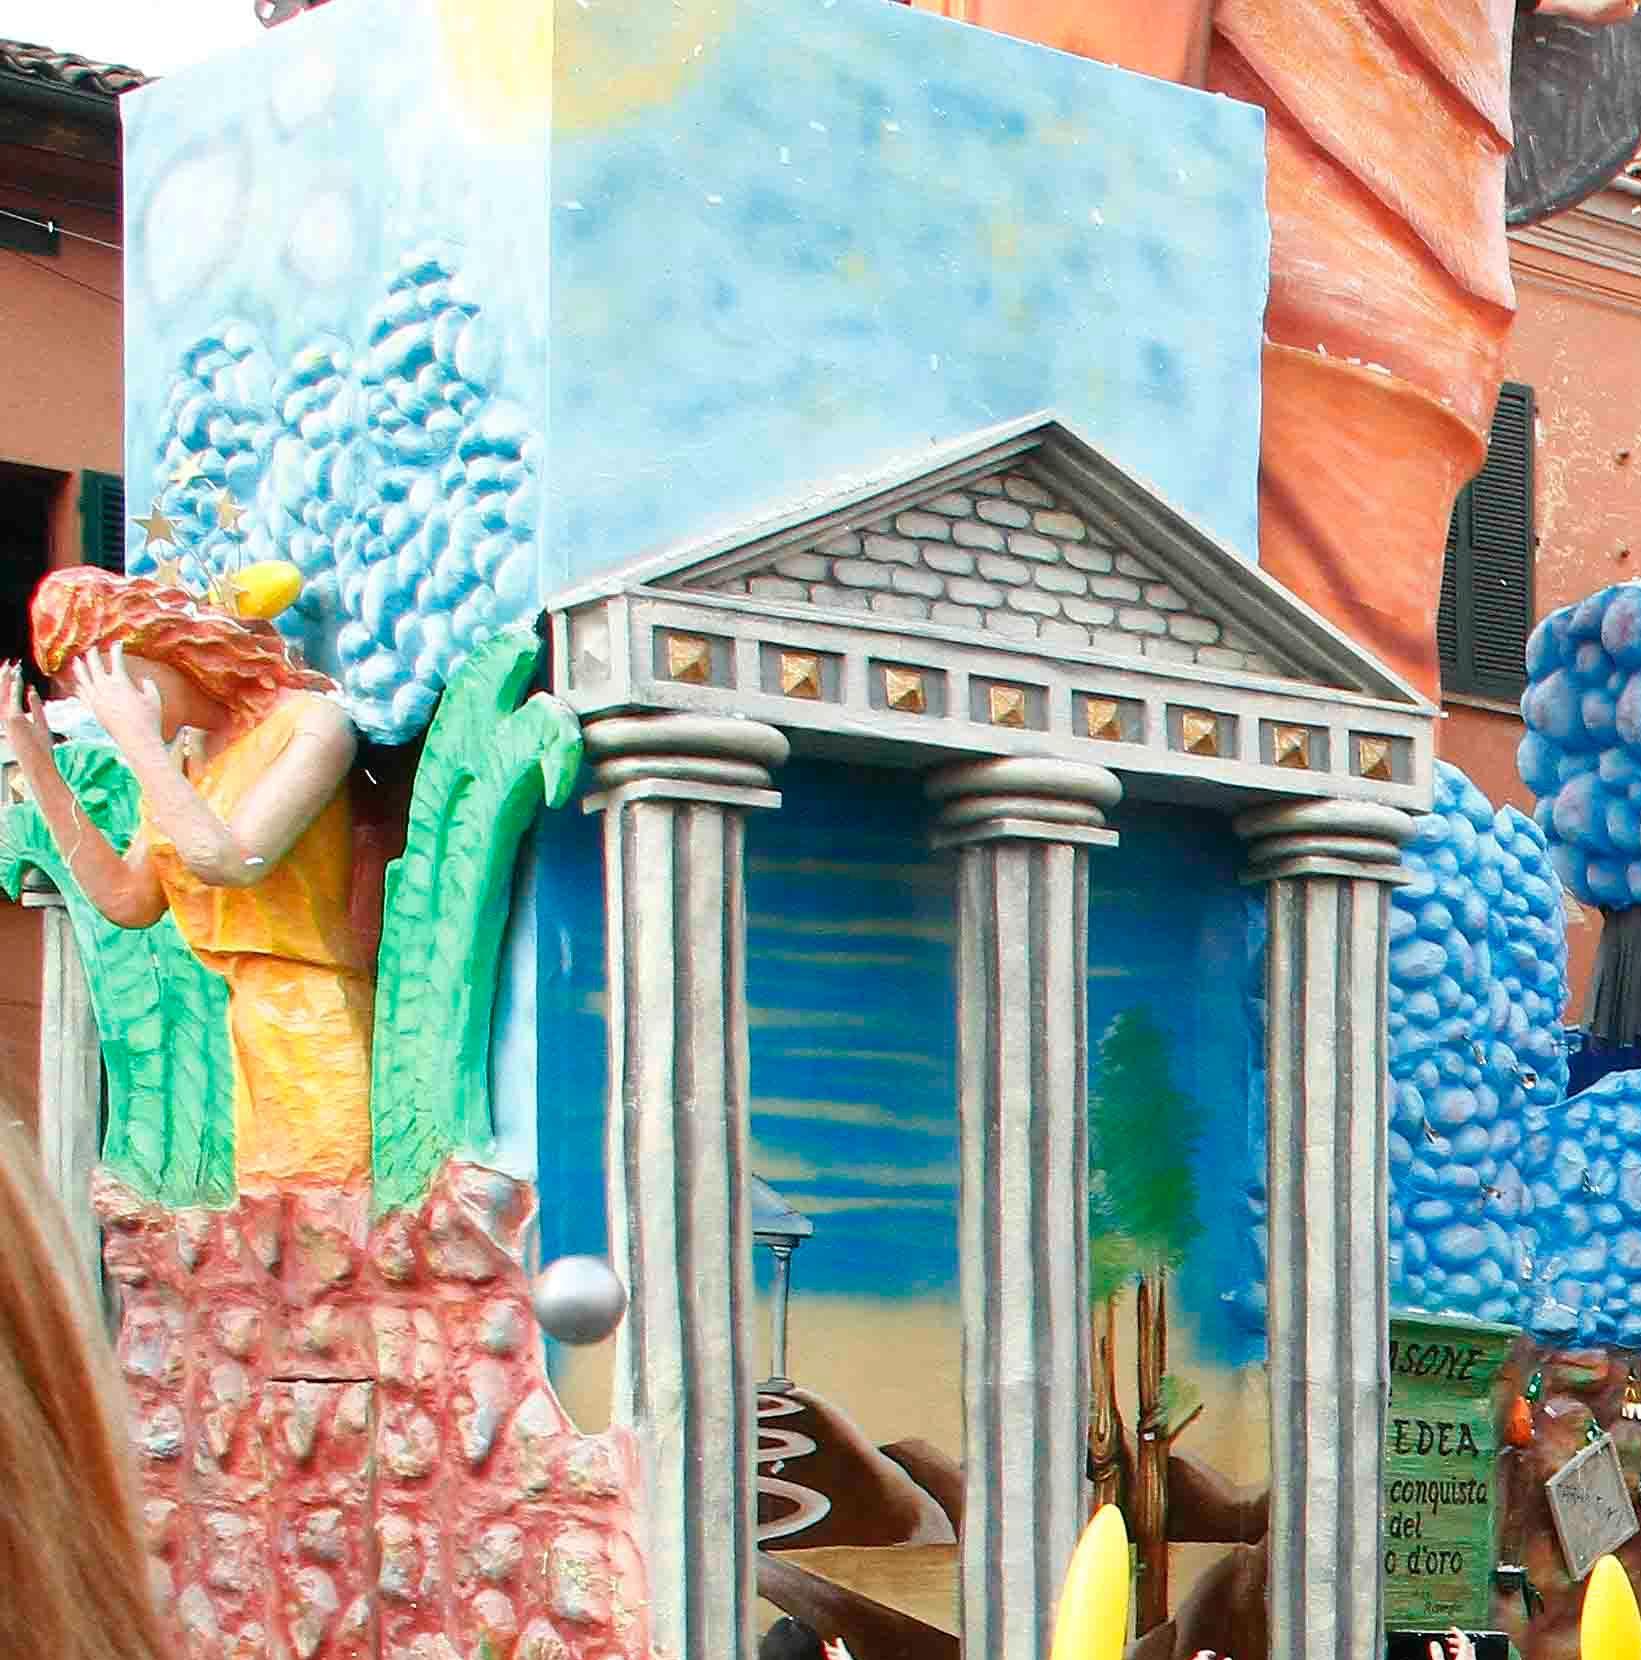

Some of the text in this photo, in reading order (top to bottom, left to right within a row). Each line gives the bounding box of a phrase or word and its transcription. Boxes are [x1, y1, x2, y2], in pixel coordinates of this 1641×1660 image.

[1390, 1476, 1488, 1514] conquista
[1390, 1511, 1423, 1539] del
[1408, 1545, 1464, 1575] d'oro
